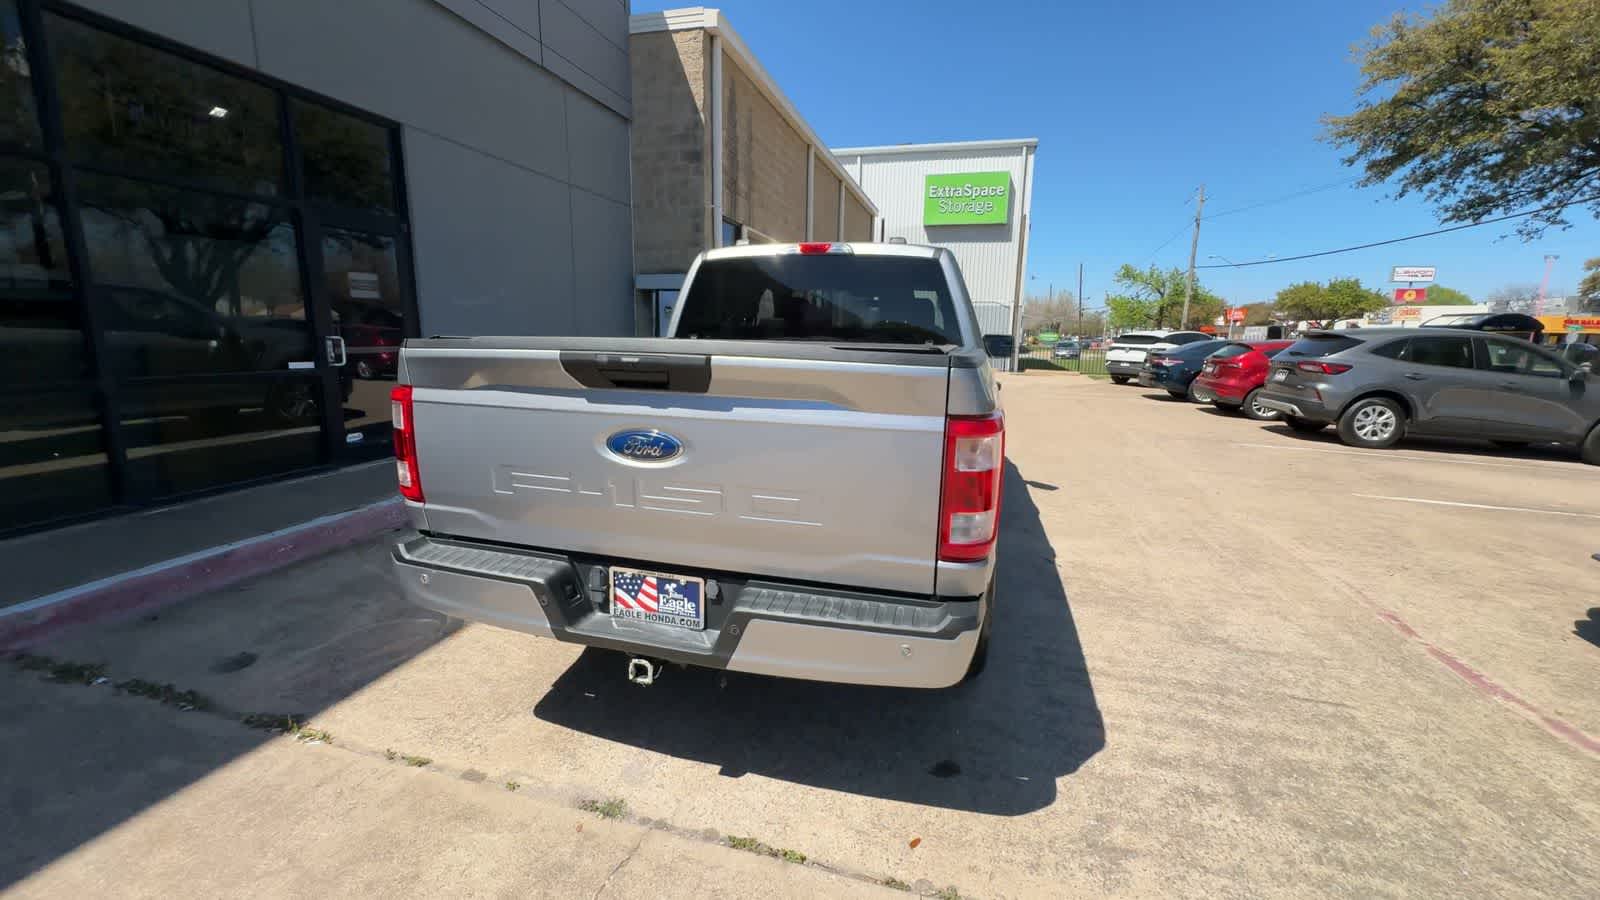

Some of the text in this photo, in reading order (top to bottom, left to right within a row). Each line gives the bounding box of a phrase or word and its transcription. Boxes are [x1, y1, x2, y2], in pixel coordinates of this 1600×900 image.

[939, 199, 993, 215] Storage
[623, 436, 666, 456] Ford
[659, 594, 696, 612] Eagle
[614, 608, 642, 618] EAGLE
[644, 612, 700, 627] HONDA.COM
